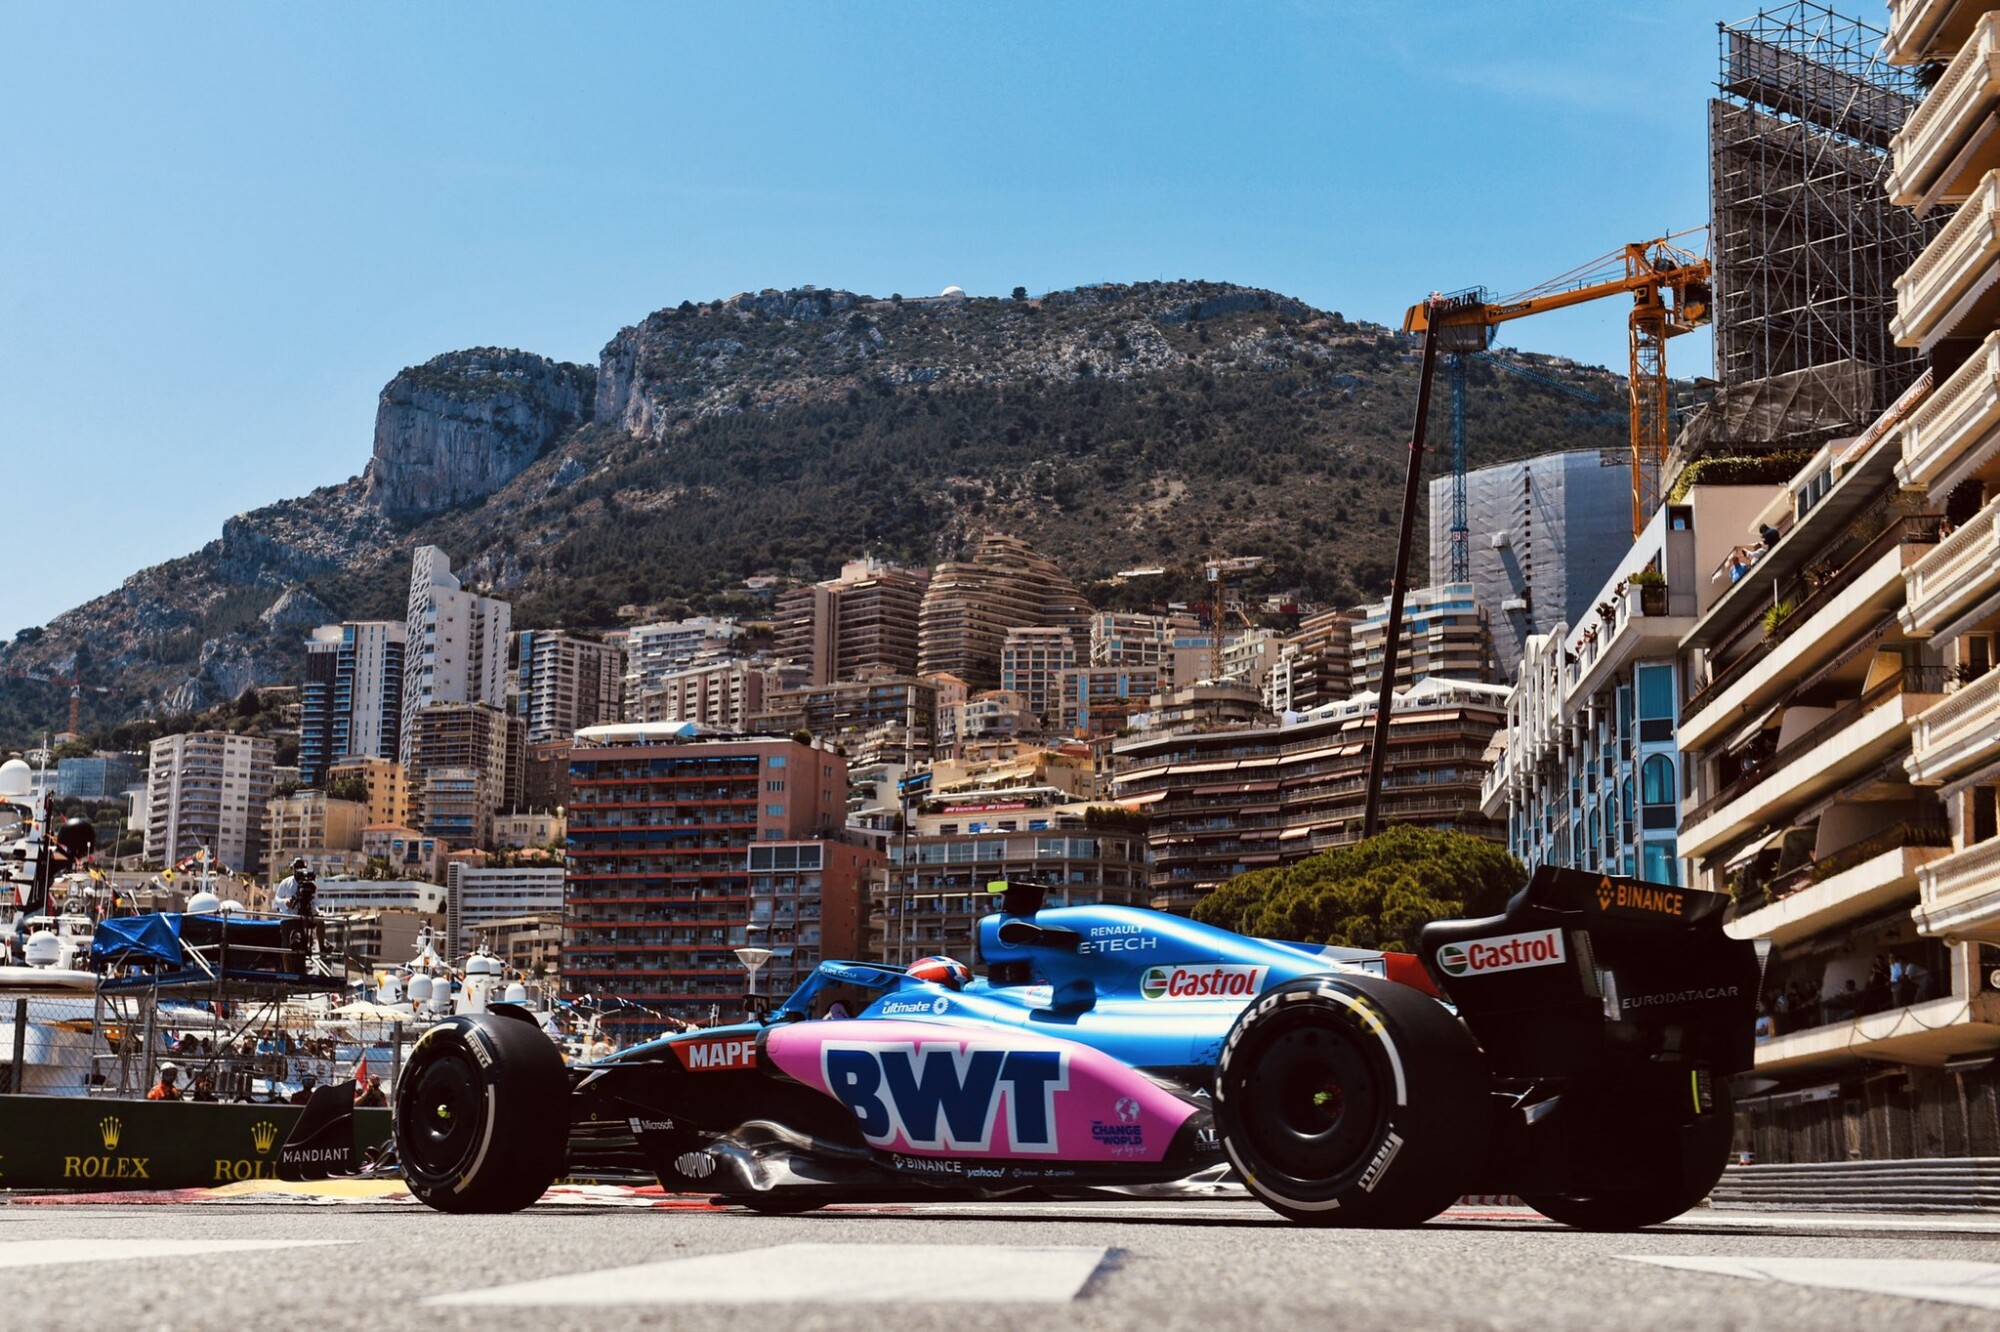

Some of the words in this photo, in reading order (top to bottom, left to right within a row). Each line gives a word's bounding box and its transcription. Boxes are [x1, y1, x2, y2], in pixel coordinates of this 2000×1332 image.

[1616, 884, 1683, 915] BINANCE
[1090, 925, 1143, 936] RENAULT
[1079, 937, 1157, 954] E-TECH
[1468, 934, 1559, 971] Castrol
[1168, 968, 1258, 997] Castrol
[1622, 985, 1738, 1009] EURODATACAR
[882, 1001, 930, 1014] ultimate
[463, 1027, 493, 1069] PIRELLI
[826, 1049, 1062, 1144] BWT
[641, 1118, 675, 1130] Microsoft
[1091, 1125, 1141, 1136] CHANGE
[1102, 1136, 1143, 1146] WORLD
[283, 1148, 349, 1164] MANDIANT
[677, 1151, 713, 1179] DUPONT
[907, 1158, 962, 1173] BINANCE
[1358, 1131, 1404, 1193] PIRELLI
[63, 1156, 150, 1179] ROLEX
[967, 1167, 1005, 1178] yahoo!
